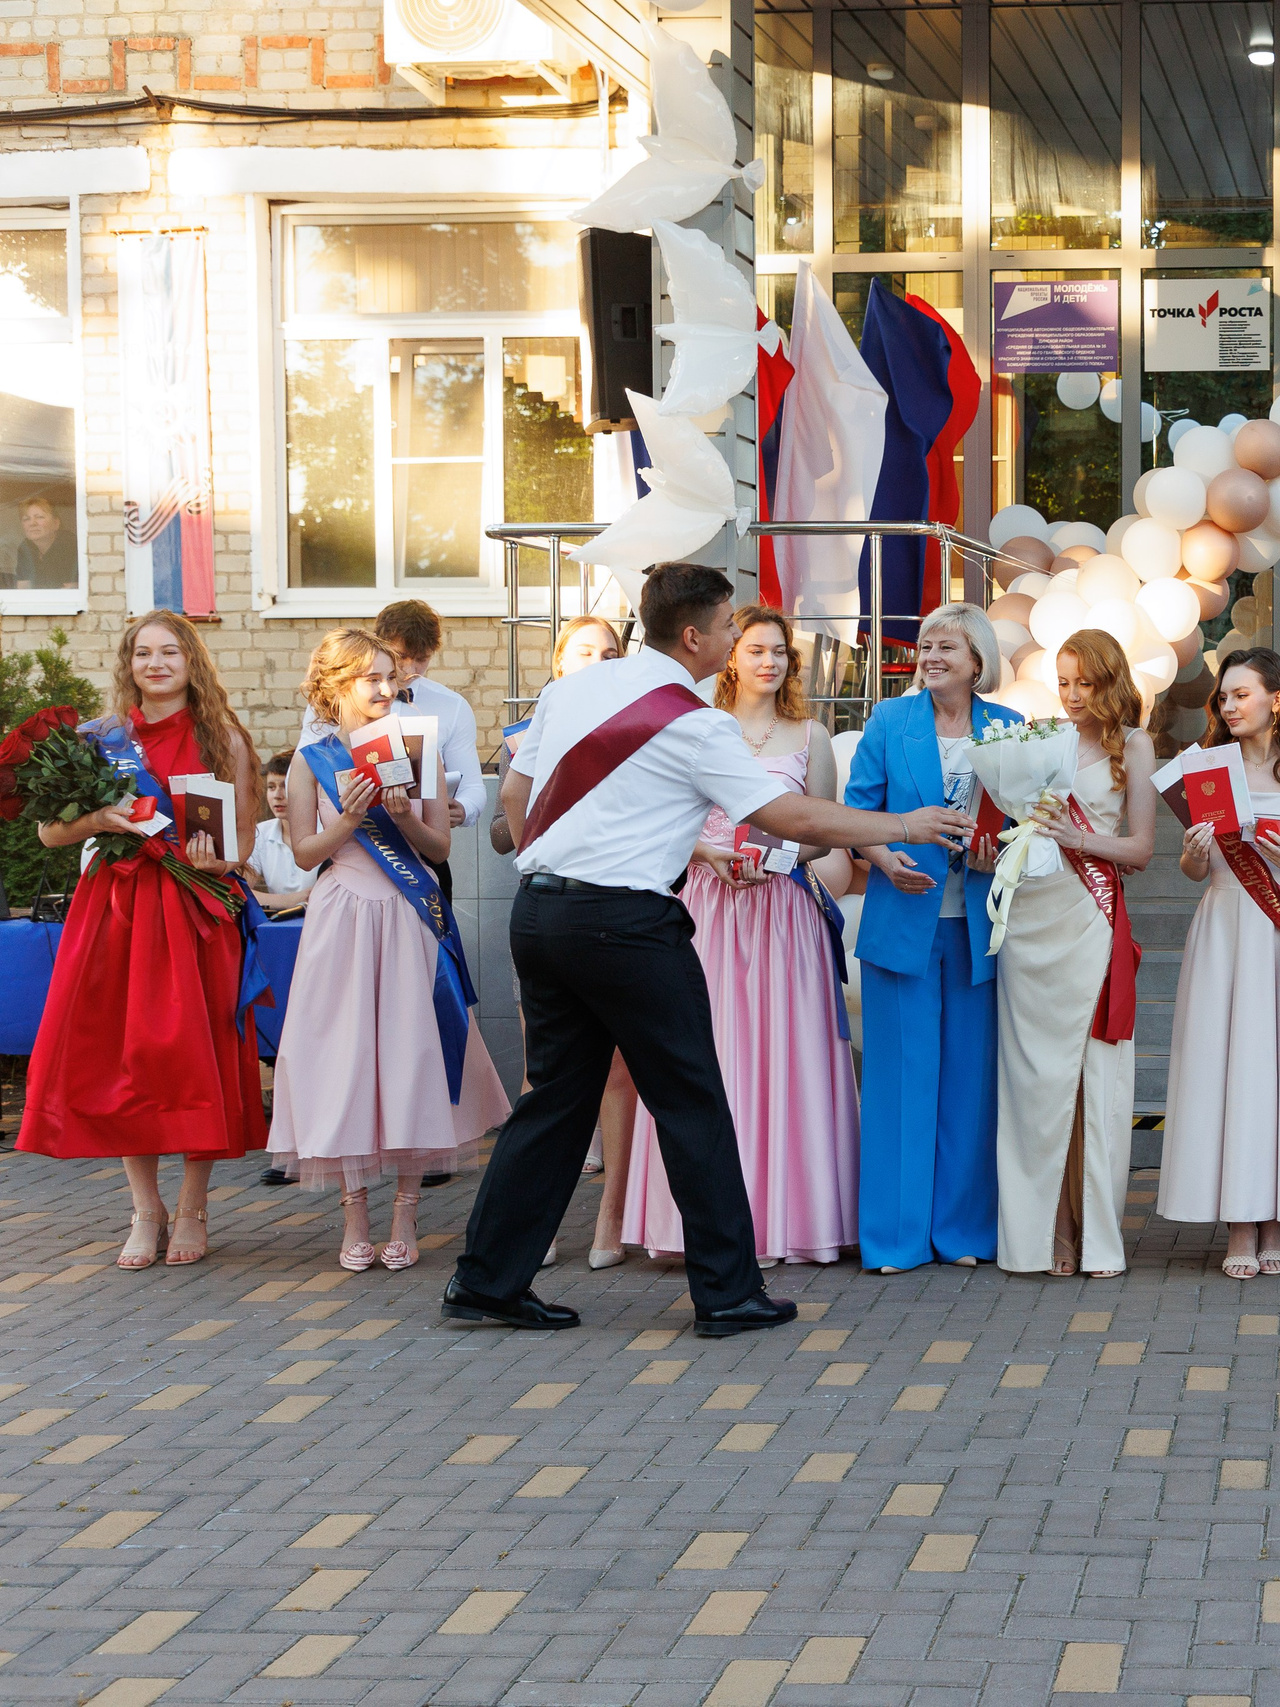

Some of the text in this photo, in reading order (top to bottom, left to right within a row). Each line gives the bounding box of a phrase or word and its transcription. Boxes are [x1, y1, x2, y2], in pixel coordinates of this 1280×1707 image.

[1053, 283, 1108, 294] МОЛОДЁЖЬ
[1053, 294, 1088, 304] И ДЕТИ
[1149, 306, 1264, 318] ТОЧКА РОСТА
